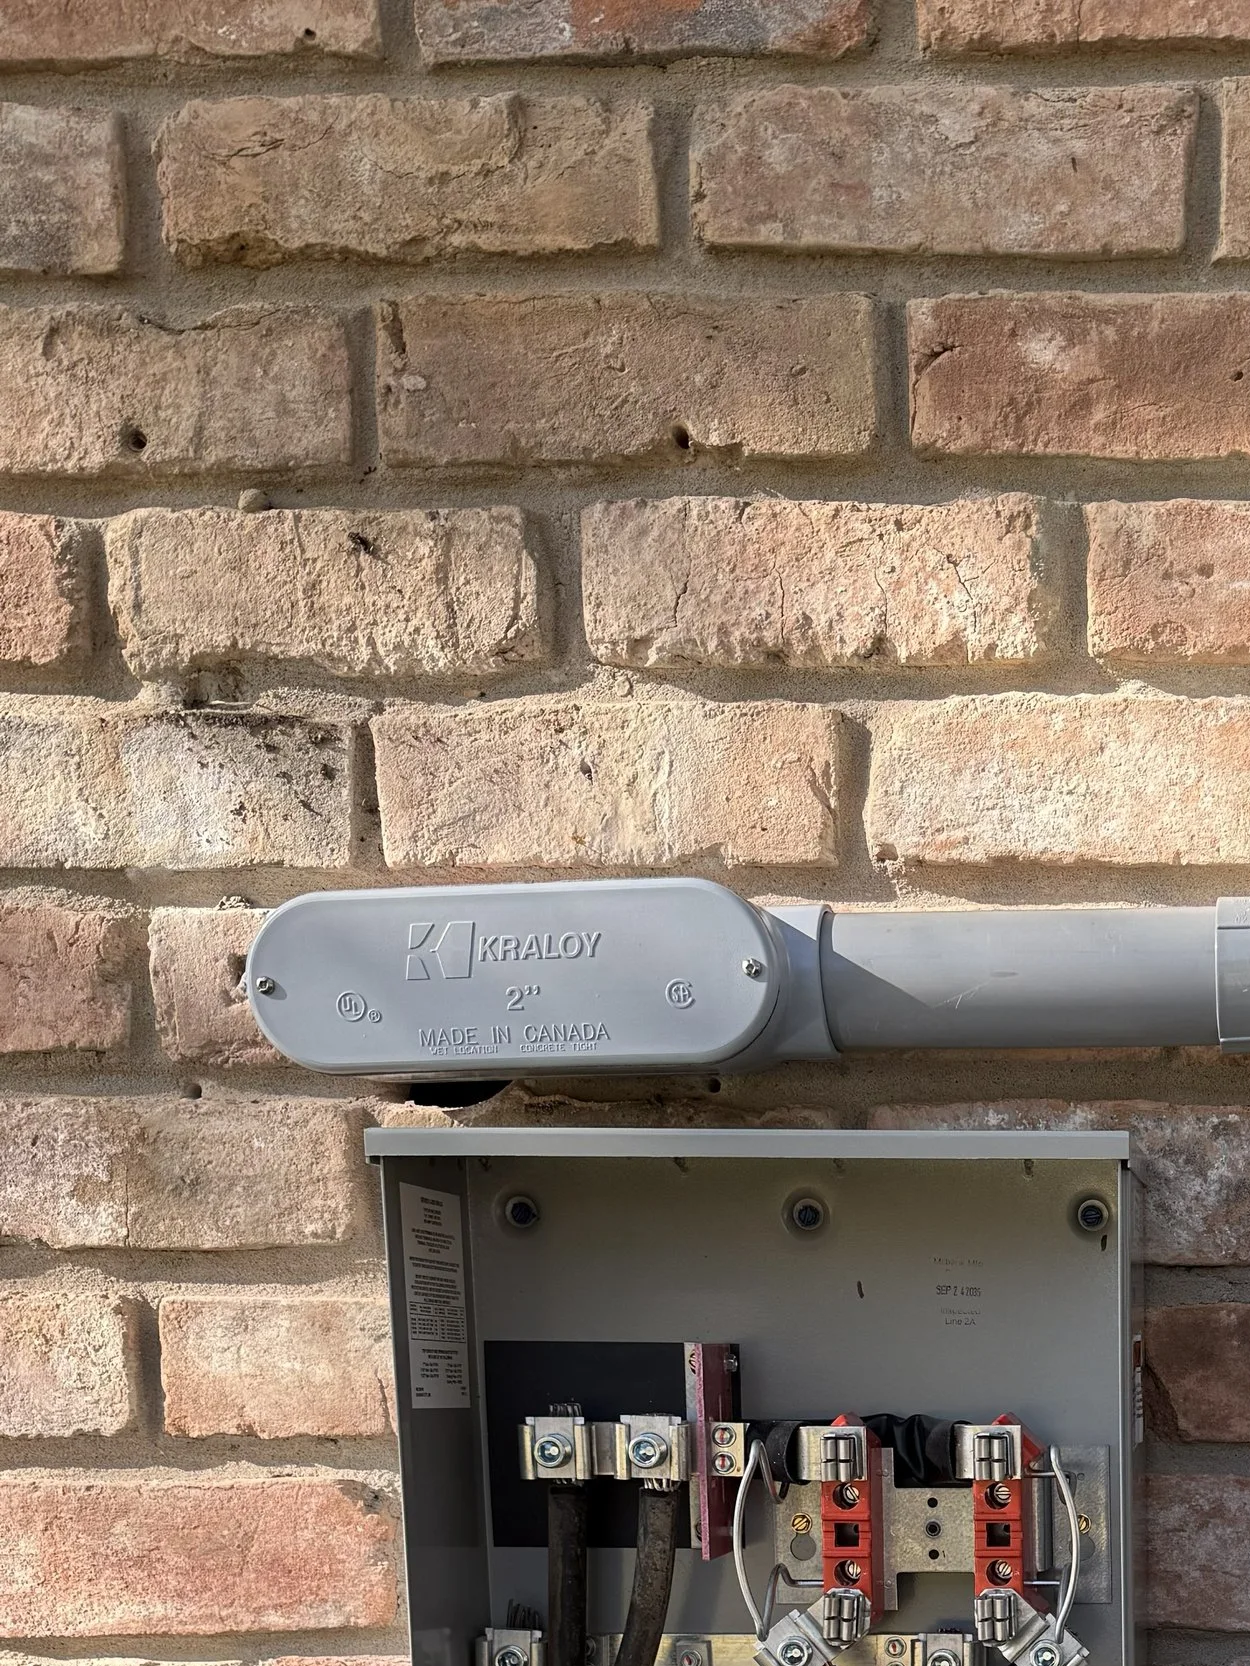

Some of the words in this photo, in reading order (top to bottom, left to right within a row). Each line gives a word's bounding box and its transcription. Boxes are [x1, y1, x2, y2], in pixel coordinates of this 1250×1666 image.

[478, 931, 602, 962] KRALOY
[418, 1026, 478, 1047] MADE
[491, 1025, 511, 1044] IN
[523, 1022, 611, 1043] CANADA
[429, 1047, 449, 1056] WET
[453, 1045, 499, 1055] LOCATION
[520, 1043, 566, 1053] CONCRETE
[572, 1042, 598, 1051] TIGHT
[935, 1284, 952, 1296] SEP
